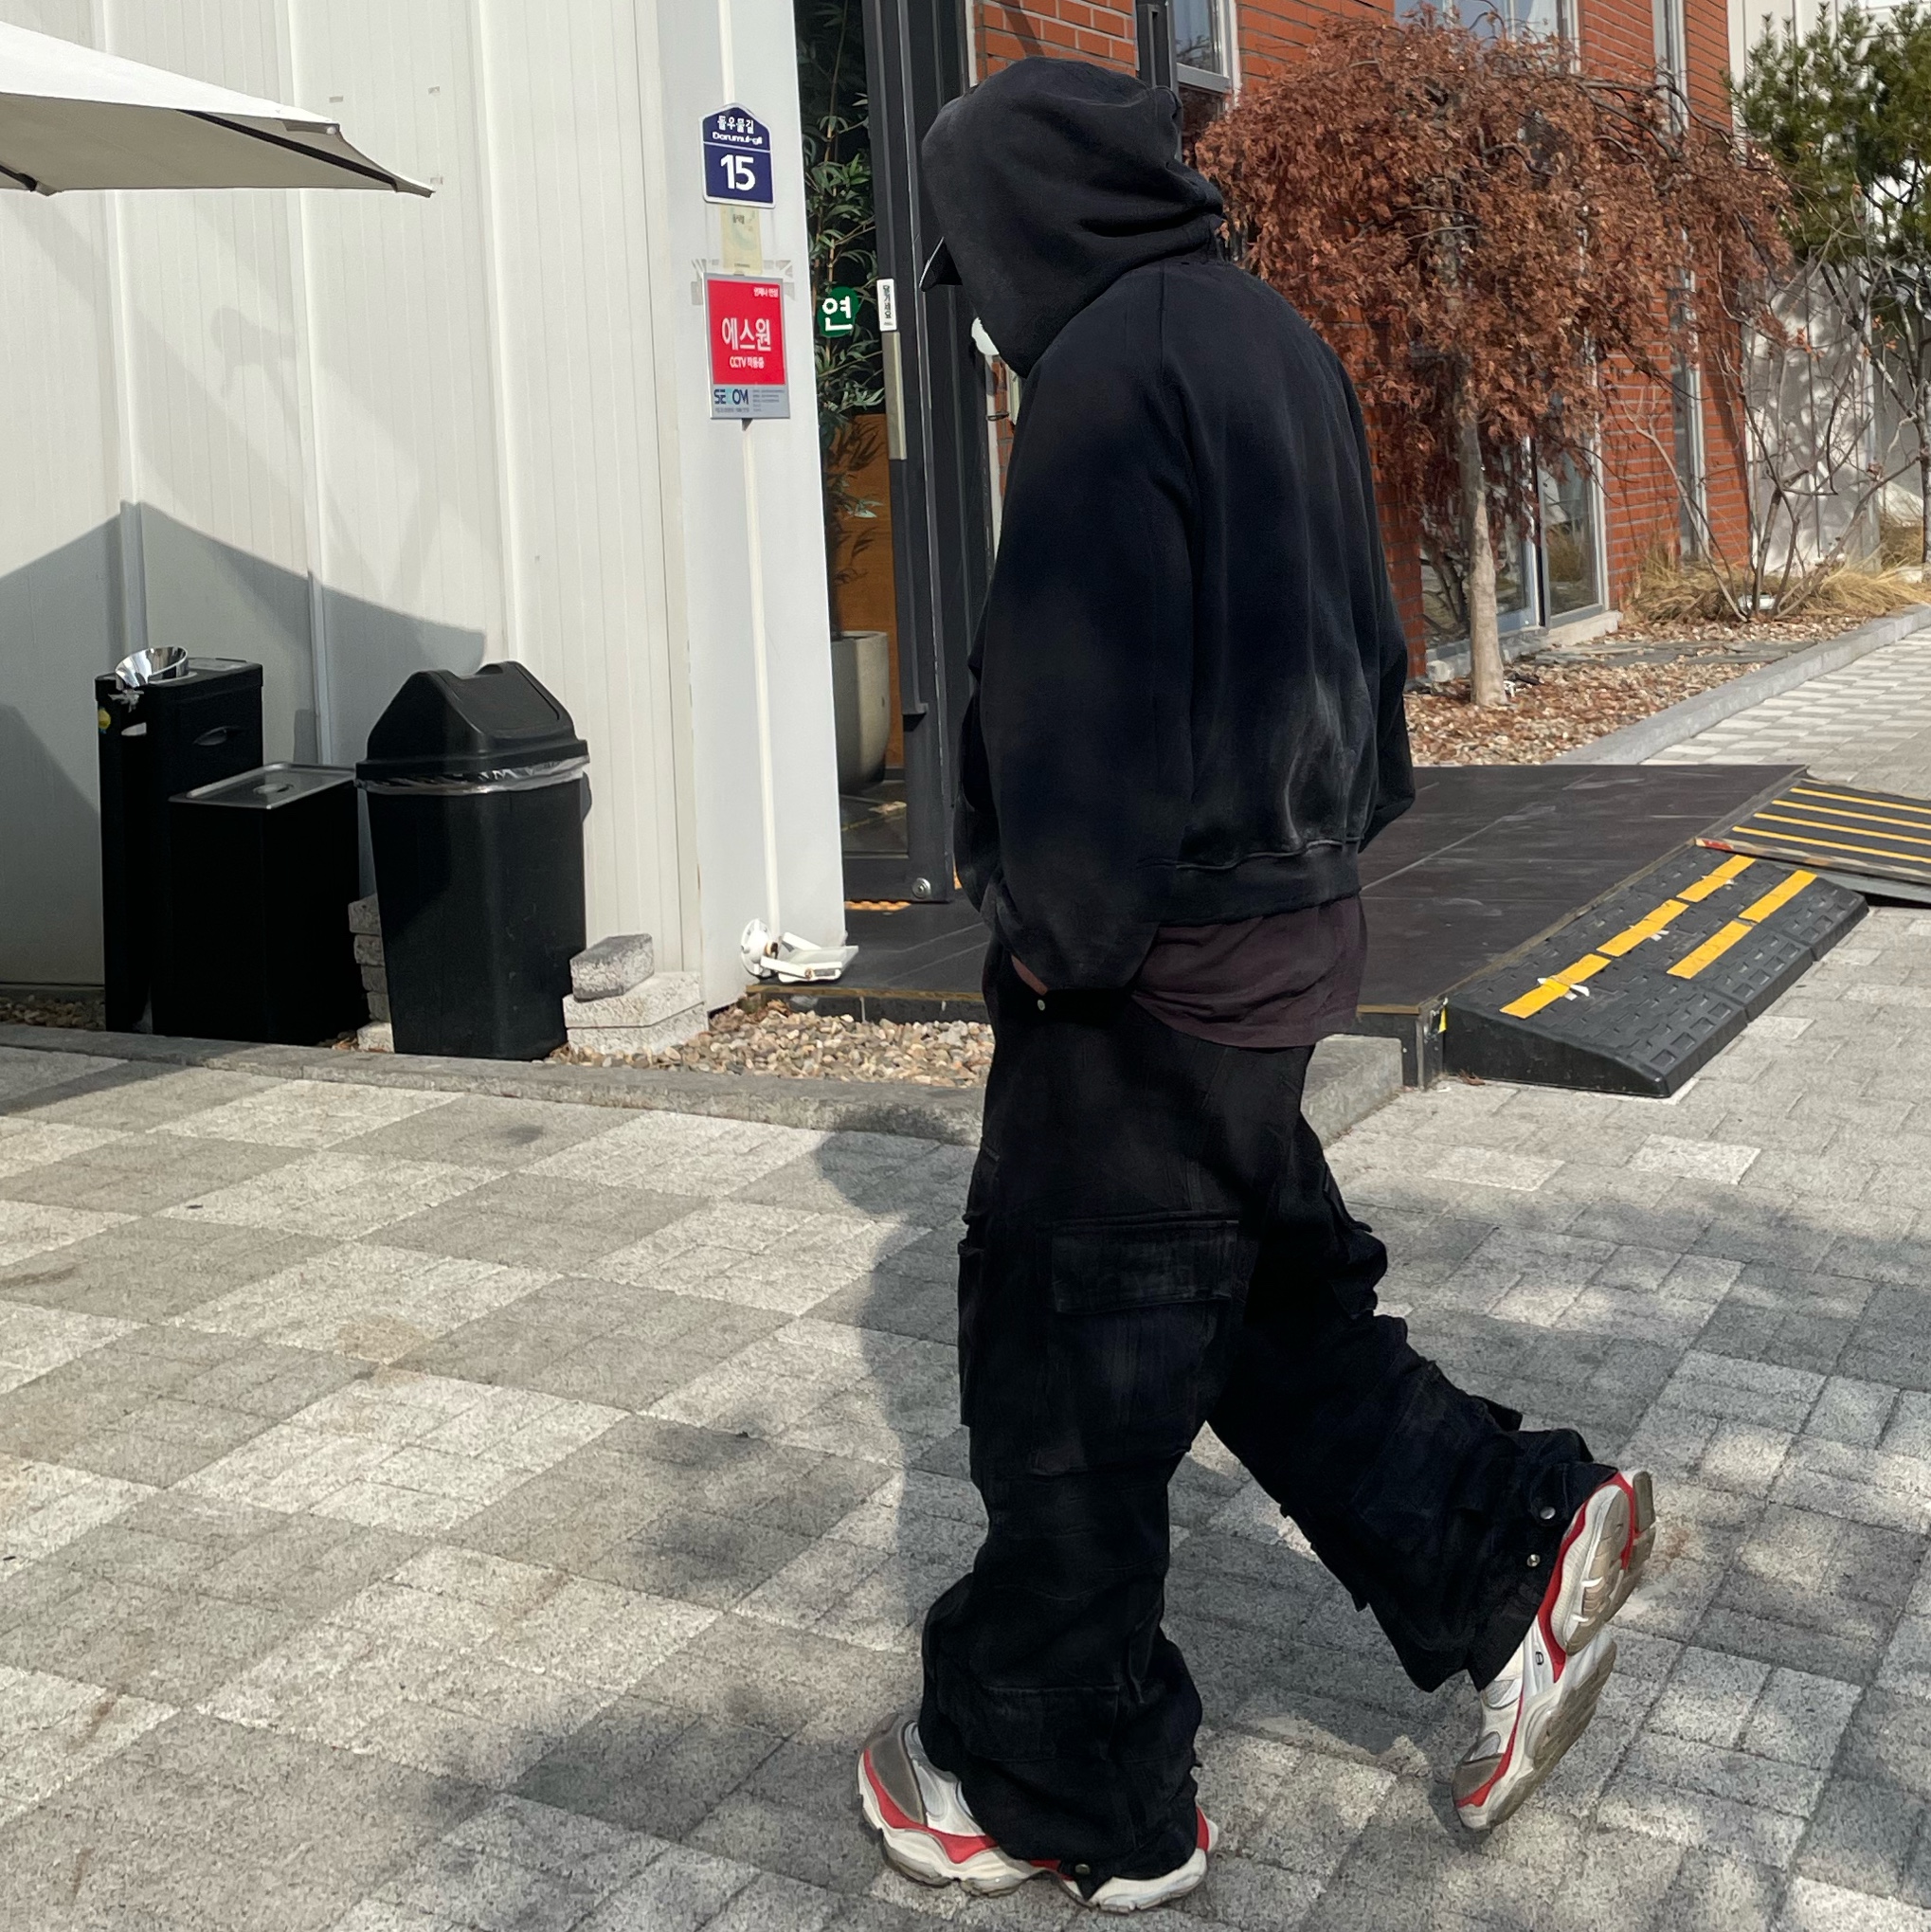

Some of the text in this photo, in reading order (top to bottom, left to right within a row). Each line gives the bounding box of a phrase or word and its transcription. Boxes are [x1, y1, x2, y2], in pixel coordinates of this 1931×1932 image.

[720, 153, 756, 191] 15
[821, 295, 853, 332] 연
[721, 316, 771, 352] 에스원
[729, 355, 765, 370] CCTV 작동중
